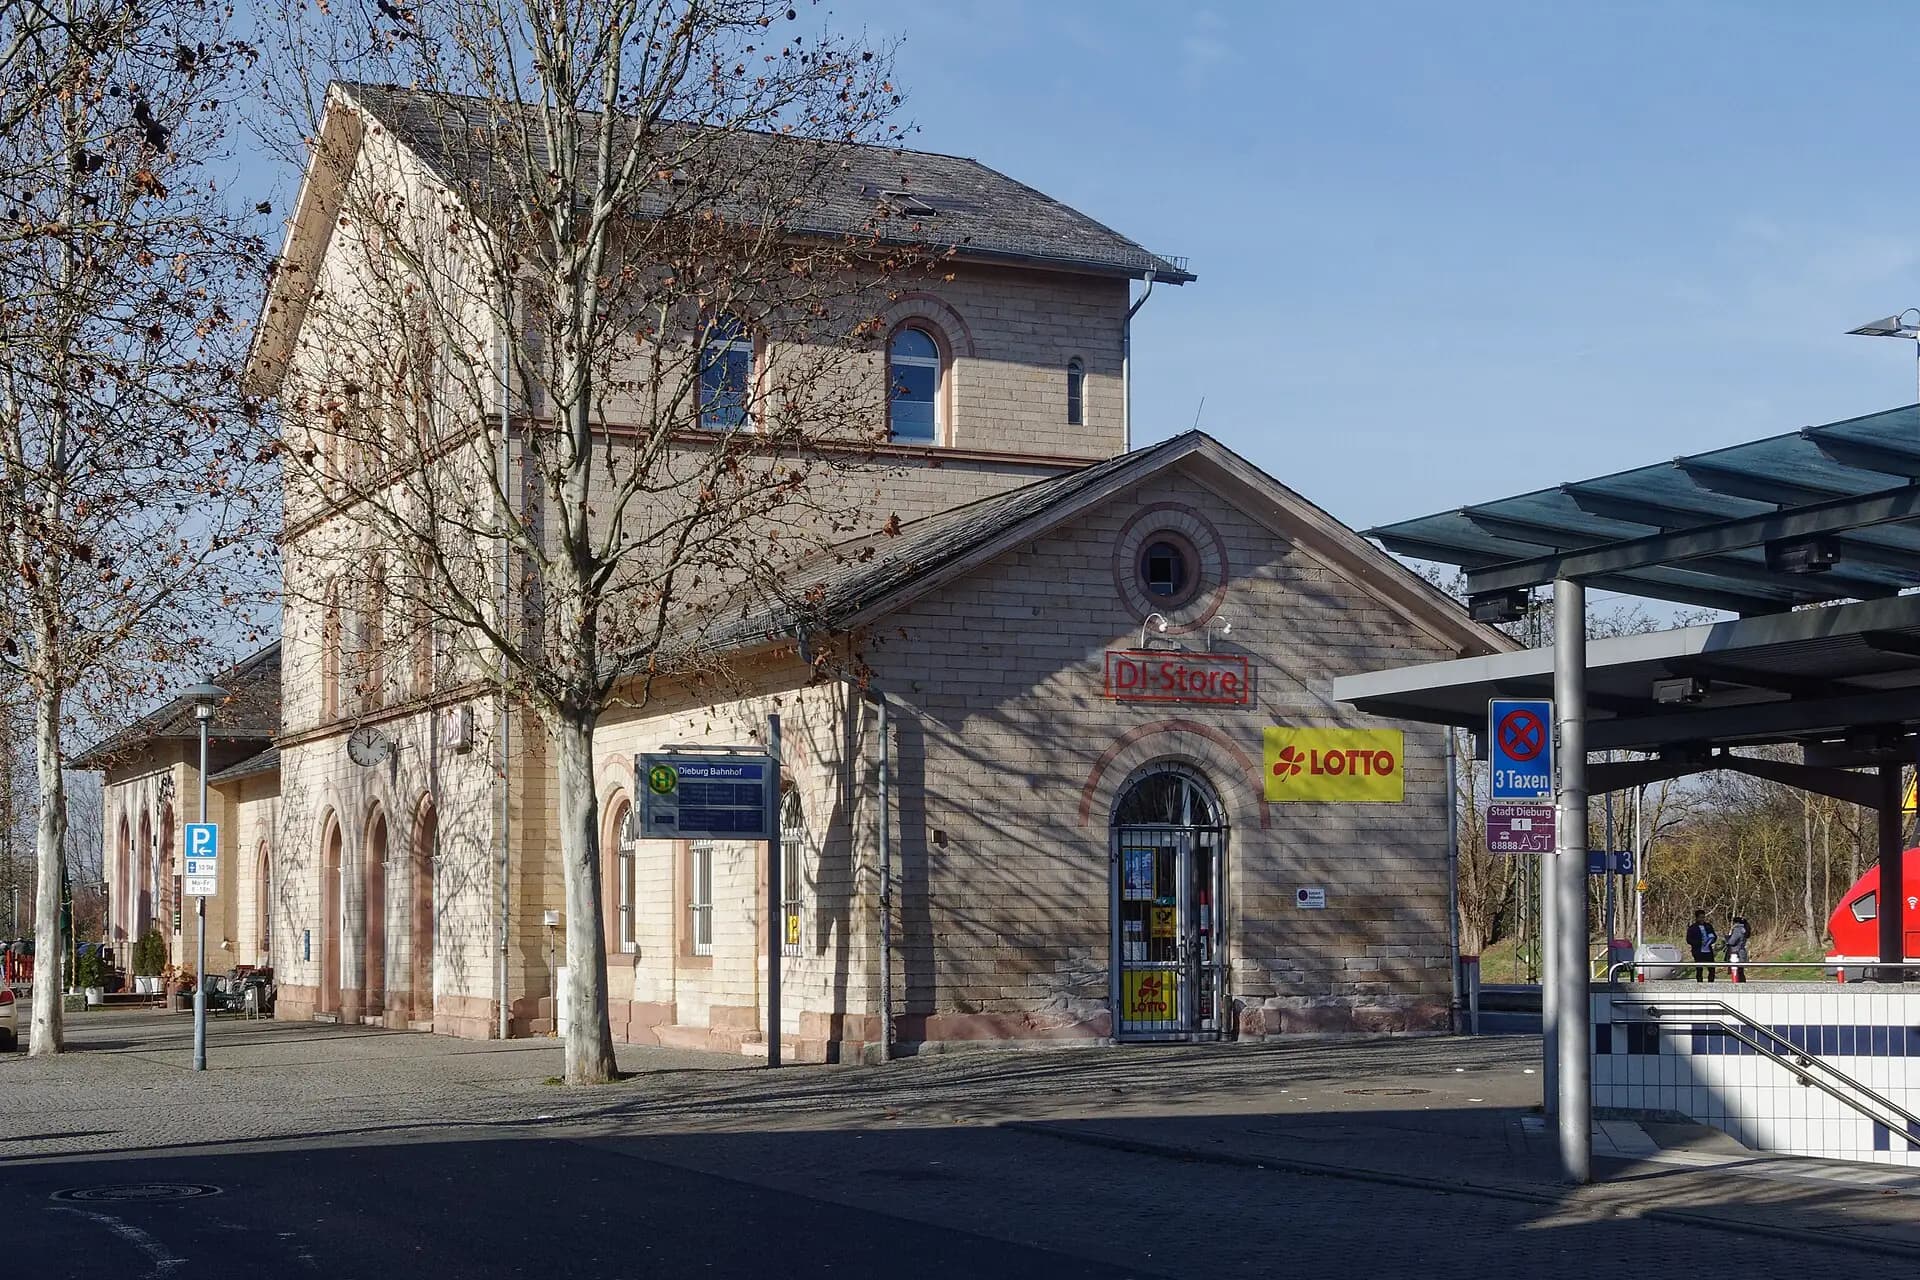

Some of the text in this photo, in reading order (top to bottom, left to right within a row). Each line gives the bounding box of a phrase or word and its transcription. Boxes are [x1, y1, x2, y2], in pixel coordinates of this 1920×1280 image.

[1116, 660, 1238, 693] DI-Store
[1310, 749, 1395, 776] LOTTO
[678, 767, 742, 777] Dieburg Bahnhof
[1495, 770, 1548, 789] 3 Taxen
[1491, 807, 1551, 819] Stadt Dieburg
[1517, 819, 1523, 829] 1
[192, 828, 210, 853] P
[1491, 841, 1518, 850] 88888
[1518, 833, 1551, 850] AST
[1622, 851, 1632, 869] 3
[1131, 1000, 1167, 1014] LOTTO
